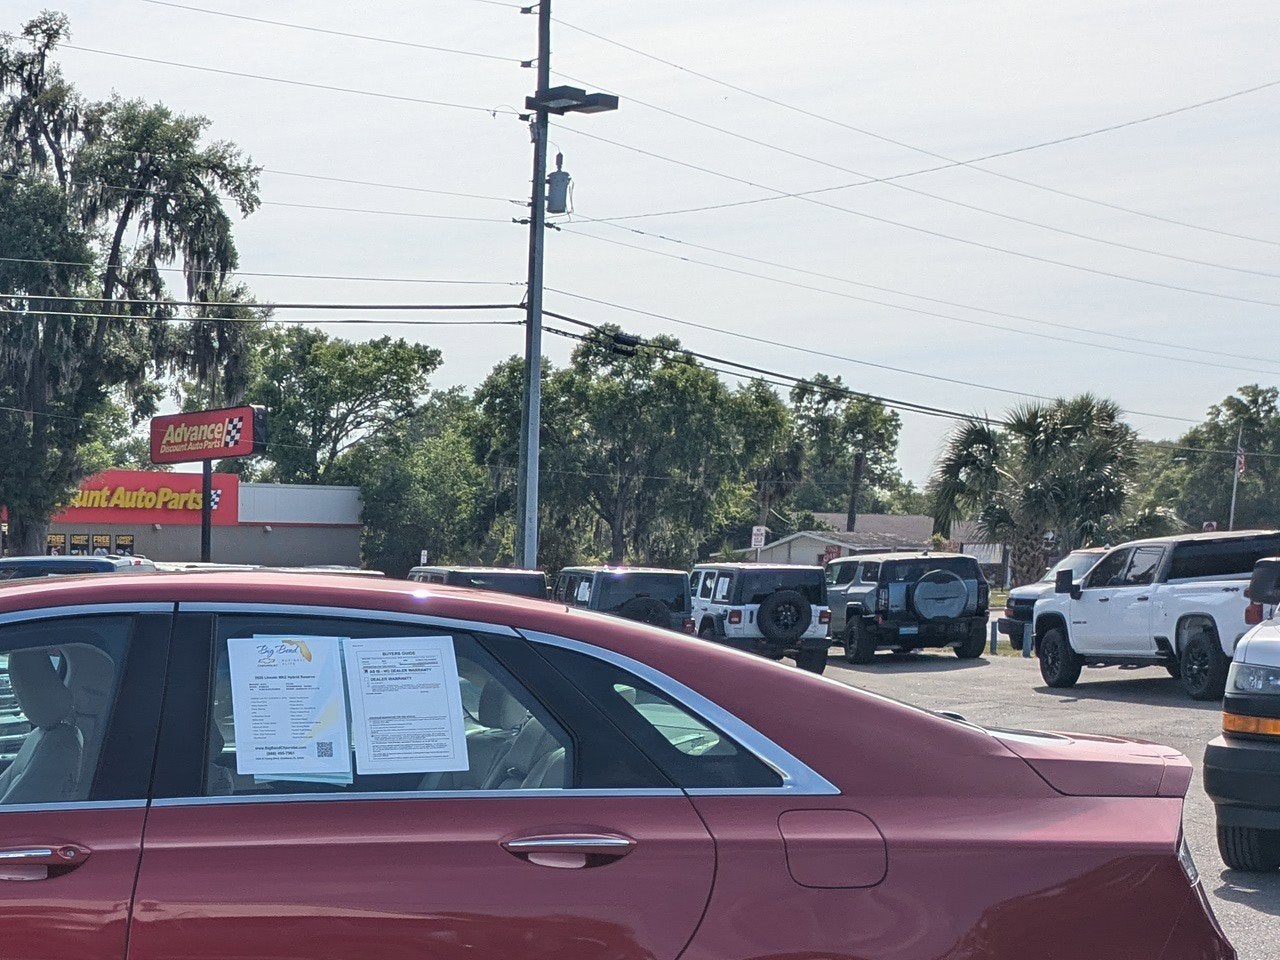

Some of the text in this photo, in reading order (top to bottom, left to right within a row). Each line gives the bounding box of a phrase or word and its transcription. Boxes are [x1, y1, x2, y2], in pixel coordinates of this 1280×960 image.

[162, 423, 223, 444] Advance
[160, 439, 222, 454] Discount Auto Parts
[110, 486, 158, 509] Auto
[156, 487, 203, 510] Parts
[275, 643, 299, 654] Bend
